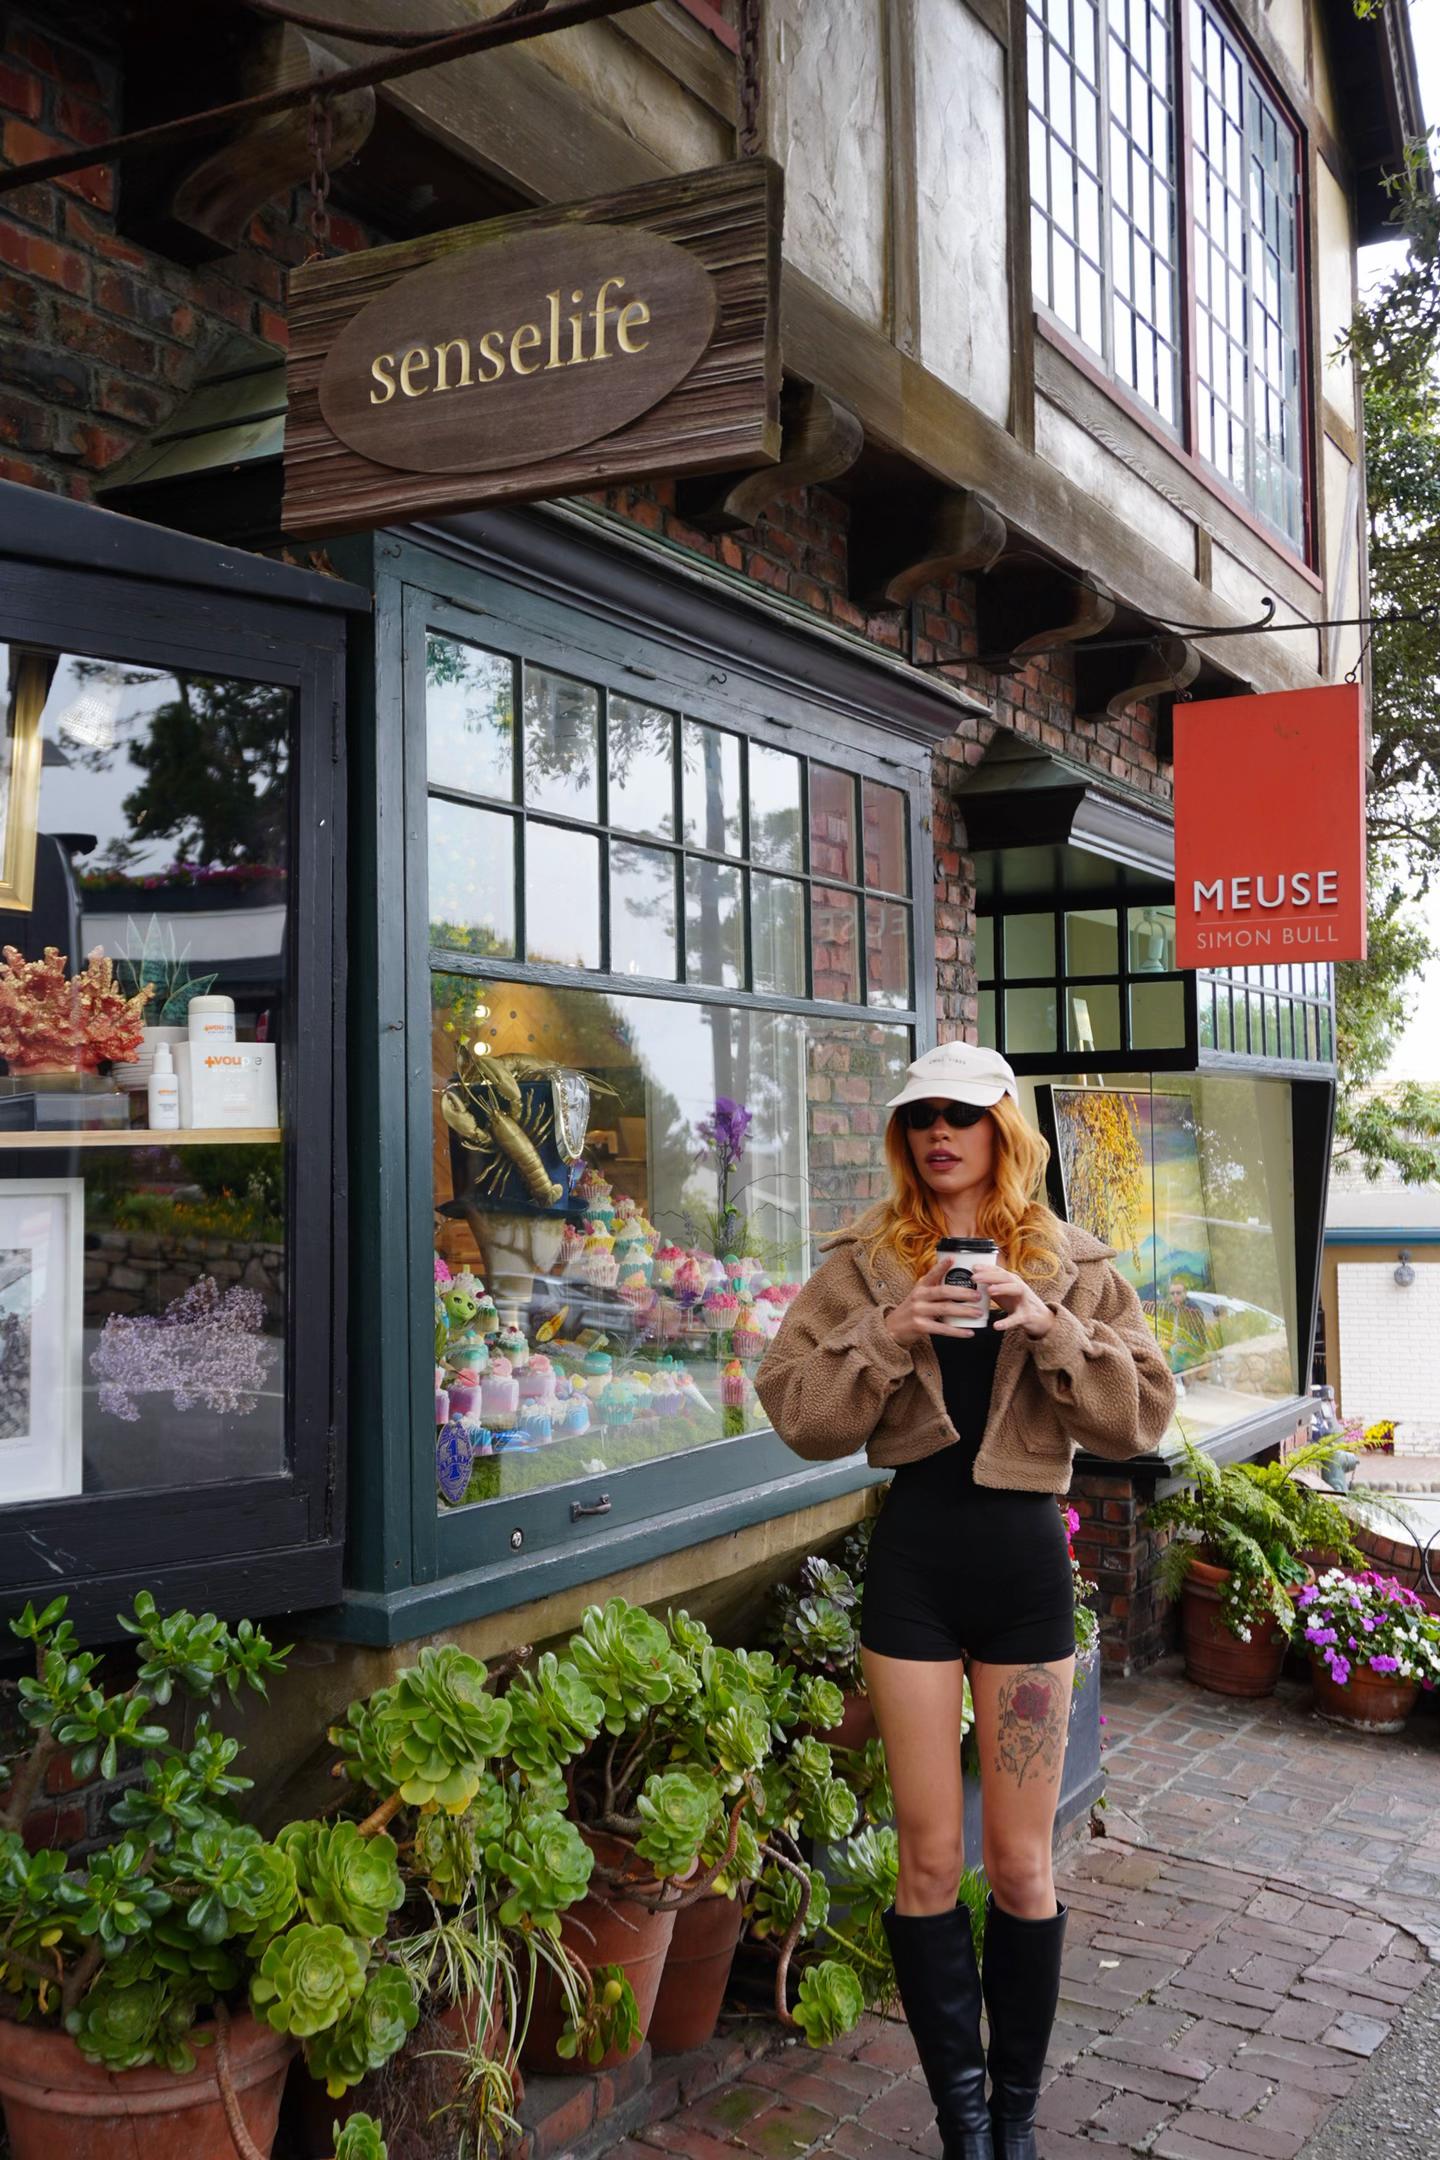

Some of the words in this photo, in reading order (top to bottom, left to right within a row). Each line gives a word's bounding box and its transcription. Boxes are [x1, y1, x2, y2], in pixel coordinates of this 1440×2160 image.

[370, 277, 650, 404] senselife
[1193, 870, 1339, 912] MEUSE
[1197, 929, 1271, 949] SIMON
[1282, 925, 1339, 945] BULL
